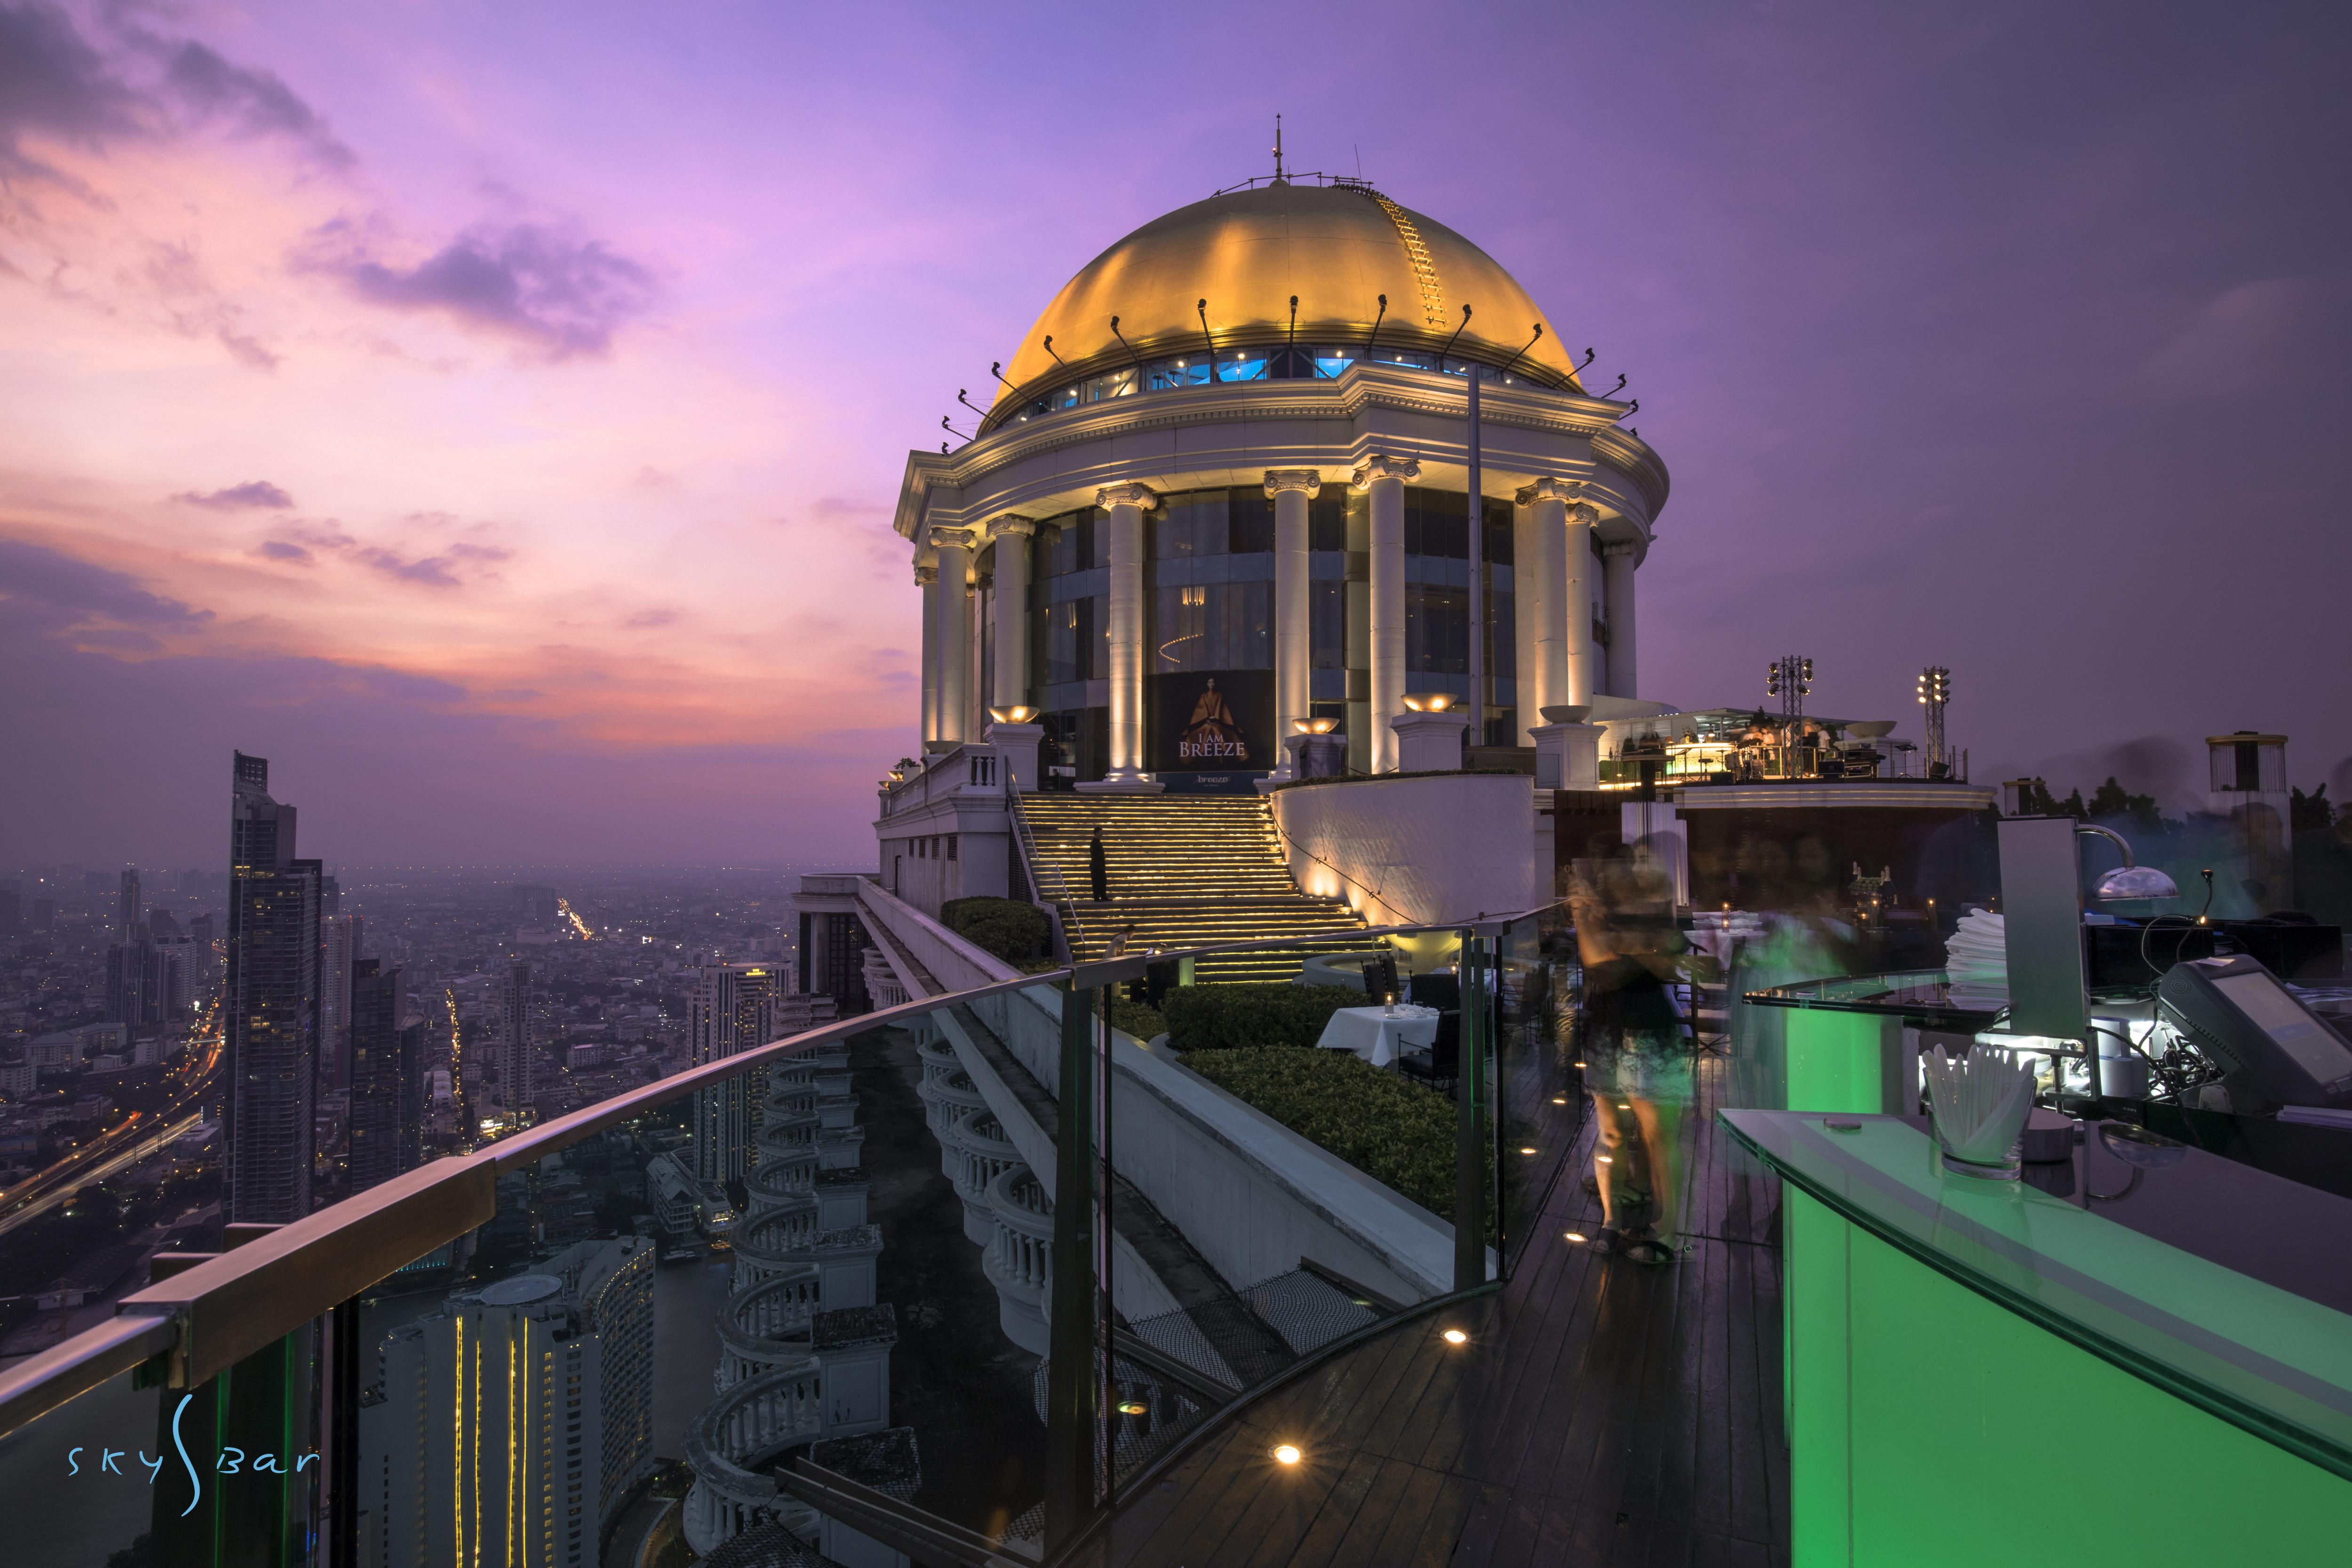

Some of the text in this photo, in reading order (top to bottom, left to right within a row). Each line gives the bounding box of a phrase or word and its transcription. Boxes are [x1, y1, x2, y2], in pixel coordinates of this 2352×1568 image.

[1199, 733, 1224, 743] I AM
[1179, 741, 1245, 757] BREEZE
